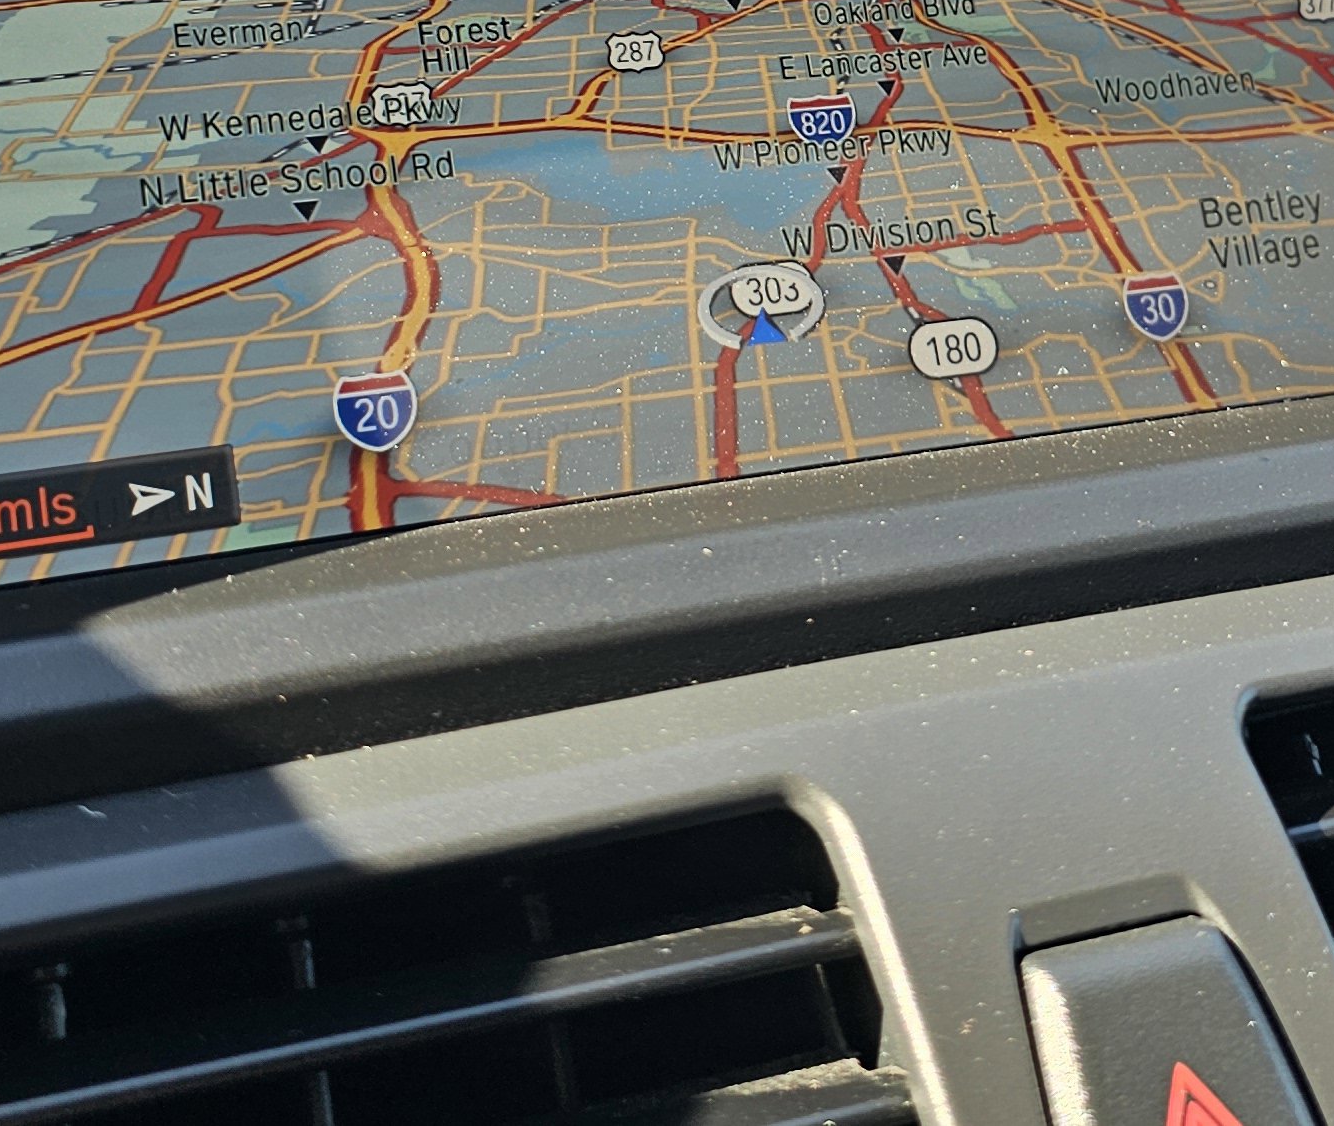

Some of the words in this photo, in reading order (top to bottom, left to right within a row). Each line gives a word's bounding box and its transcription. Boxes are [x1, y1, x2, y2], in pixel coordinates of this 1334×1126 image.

[174, 18, 303, 50] Everman
[419, 18, 512, 48] Forest
[422, 44, 471, 74] Hill
[616, 38, 656, 64] 287
[779, 55, 797, 81] E
[806, 45, 939, 78] Lancaster
[943, 43, 989, 67] Ave
[1095, 70, 1255, 105] Woodhaven
[158, 115, 189, 144] W
[202, 100, 371, 141] Kennedale
[385, 95, 463, 124] Pkwy
[800, 110, 846, 138] 820
[714, 142, 743, 171] W
[751, 135, 869, 166] Pioneer
[878, 126, 953, 157] Pkwy
[140, 177, 165, 206] N
[178, 171, 267, 204] Little
[279, 158, 399, 199] School
[412, 150, 455, 183] Rd
[1200, 192, 1323, 232] Bentley
[782, 225, 813, 255] W
[822, 216, 960, 251] Division
[968, 207, 999, 236] St
[1208, 232, 1322, 270] Village
[747, 275, 800, 306] 303
[1142, 296, 1175, 323] 30
[926, 333, 982, 366] 180
[353, 397, 399, 432] 20
[185, 474, 215, 510] N
